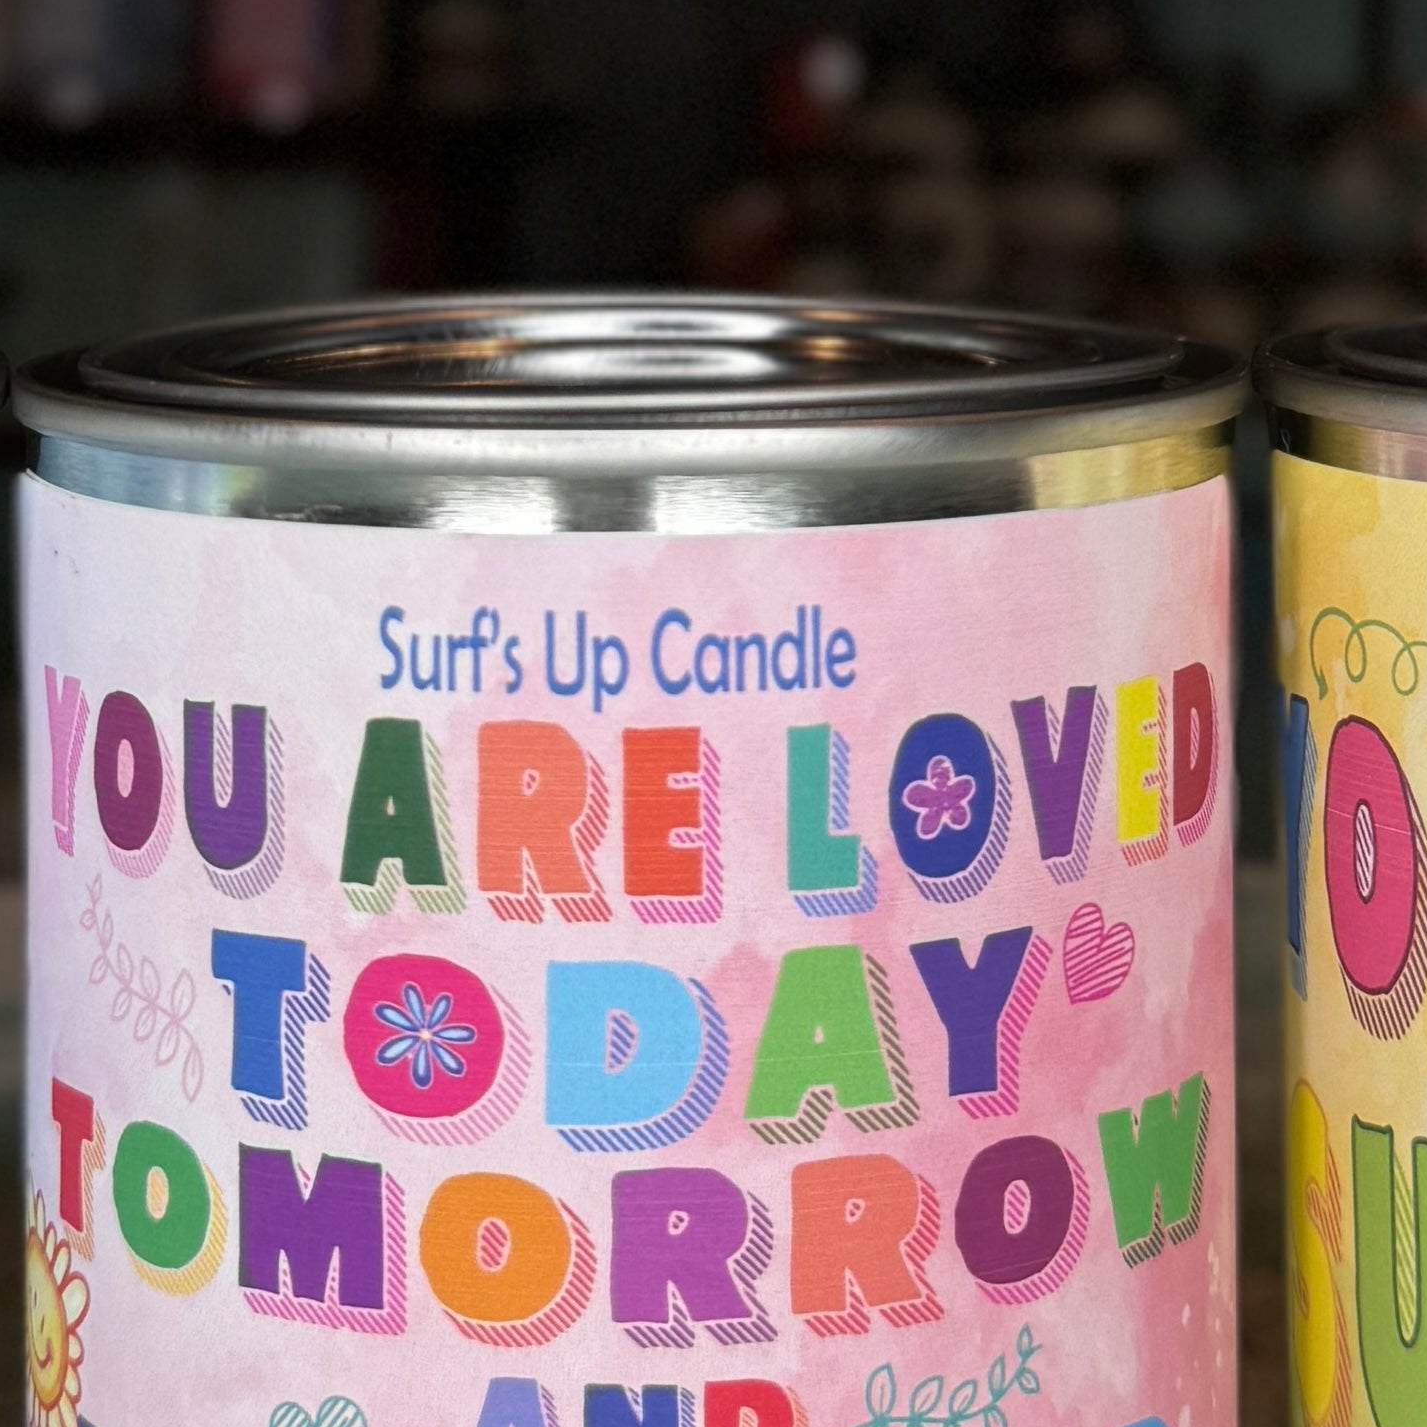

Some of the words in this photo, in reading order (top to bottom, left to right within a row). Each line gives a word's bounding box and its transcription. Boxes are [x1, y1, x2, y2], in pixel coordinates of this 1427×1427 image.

[380, 605, 524, 694] Surf's
[544, 610, 630, 713] Up
[650, 604, 857, 695] Candle
[45, 664, 285, 900] YOU
[340, 716, 723, 924] ARE
[787, 661, 1219, 918] LOVED
[212, 925, 1054, 1152] TODAY
[52, 1070, 1212, 1349] TOMORROW
